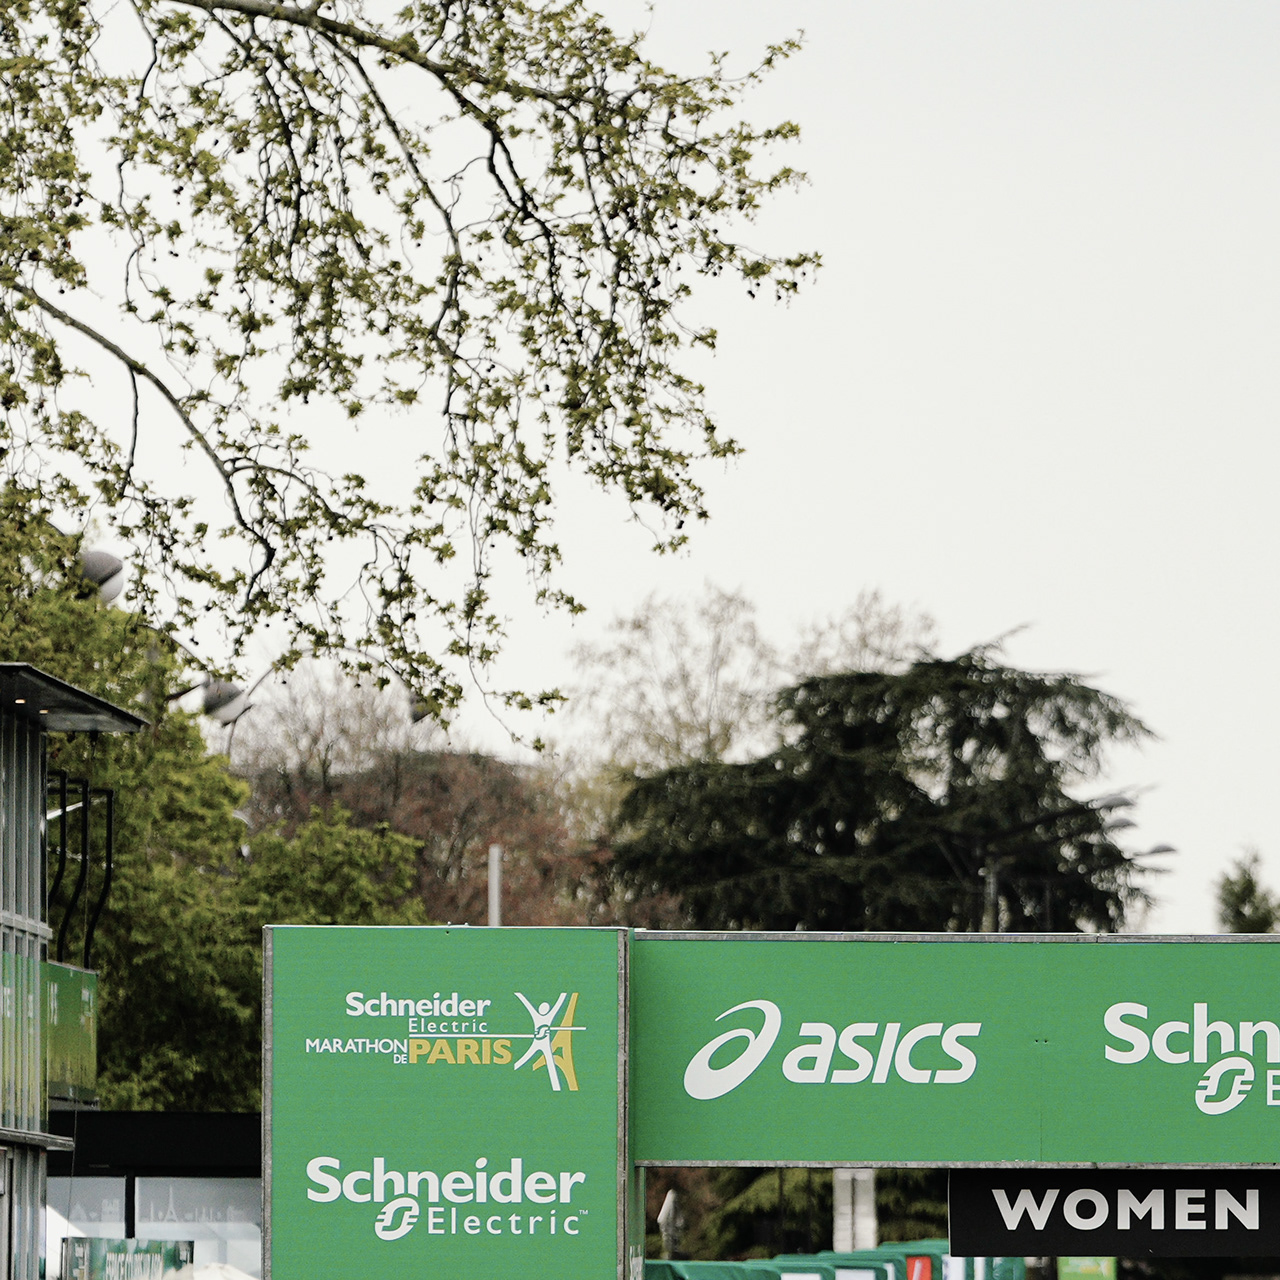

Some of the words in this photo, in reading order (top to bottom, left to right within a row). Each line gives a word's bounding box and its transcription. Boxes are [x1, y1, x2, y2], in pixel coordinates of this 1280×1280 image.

[346, 992, 491, 1017] Schneider
[409, 1018, 487, 1032] Electric
[306, 1039, 407, 1053] MARATHON
[394, 1054, 407, 1063] DE
[409, 1040, 512, 1064] PARIS
[307, 1157, 586, 1204] Schneider
[428, 1207, 580, 1235] Electric
[992, 1190, 1259, 1230] WOMEN
